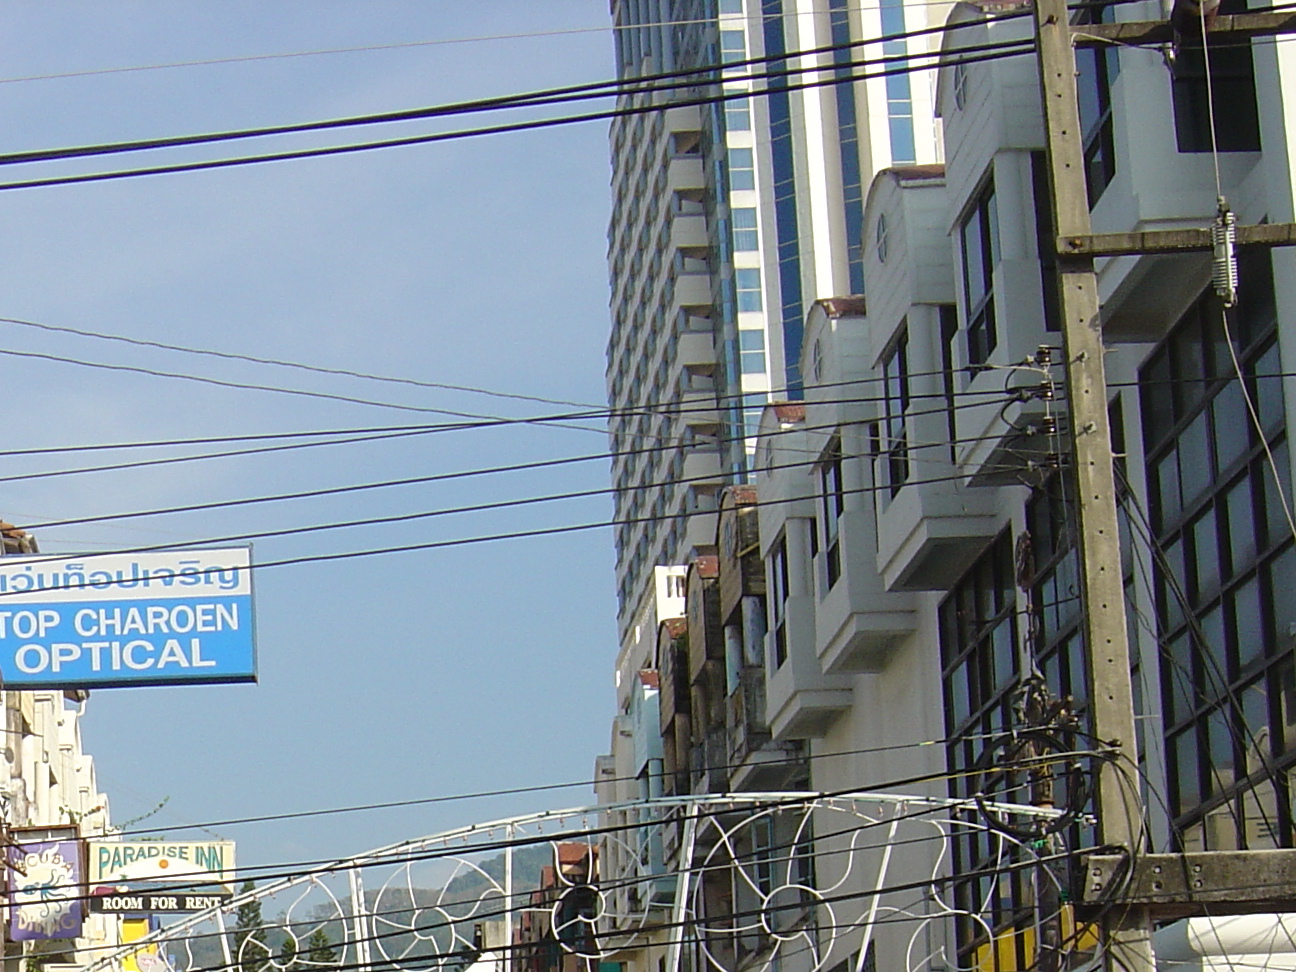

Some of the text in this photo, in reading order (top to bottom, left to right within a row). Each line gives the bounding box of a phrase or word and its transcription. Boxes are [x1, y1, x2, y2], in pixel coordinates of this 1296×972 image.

[74, 603, 239, 636] CHAROEN
[15, 638, 216, 674] OPTICAL
[99, 846, 223, 880] PARADISE INN
[103, 896, 222, 910] ROOM FOR RENT
